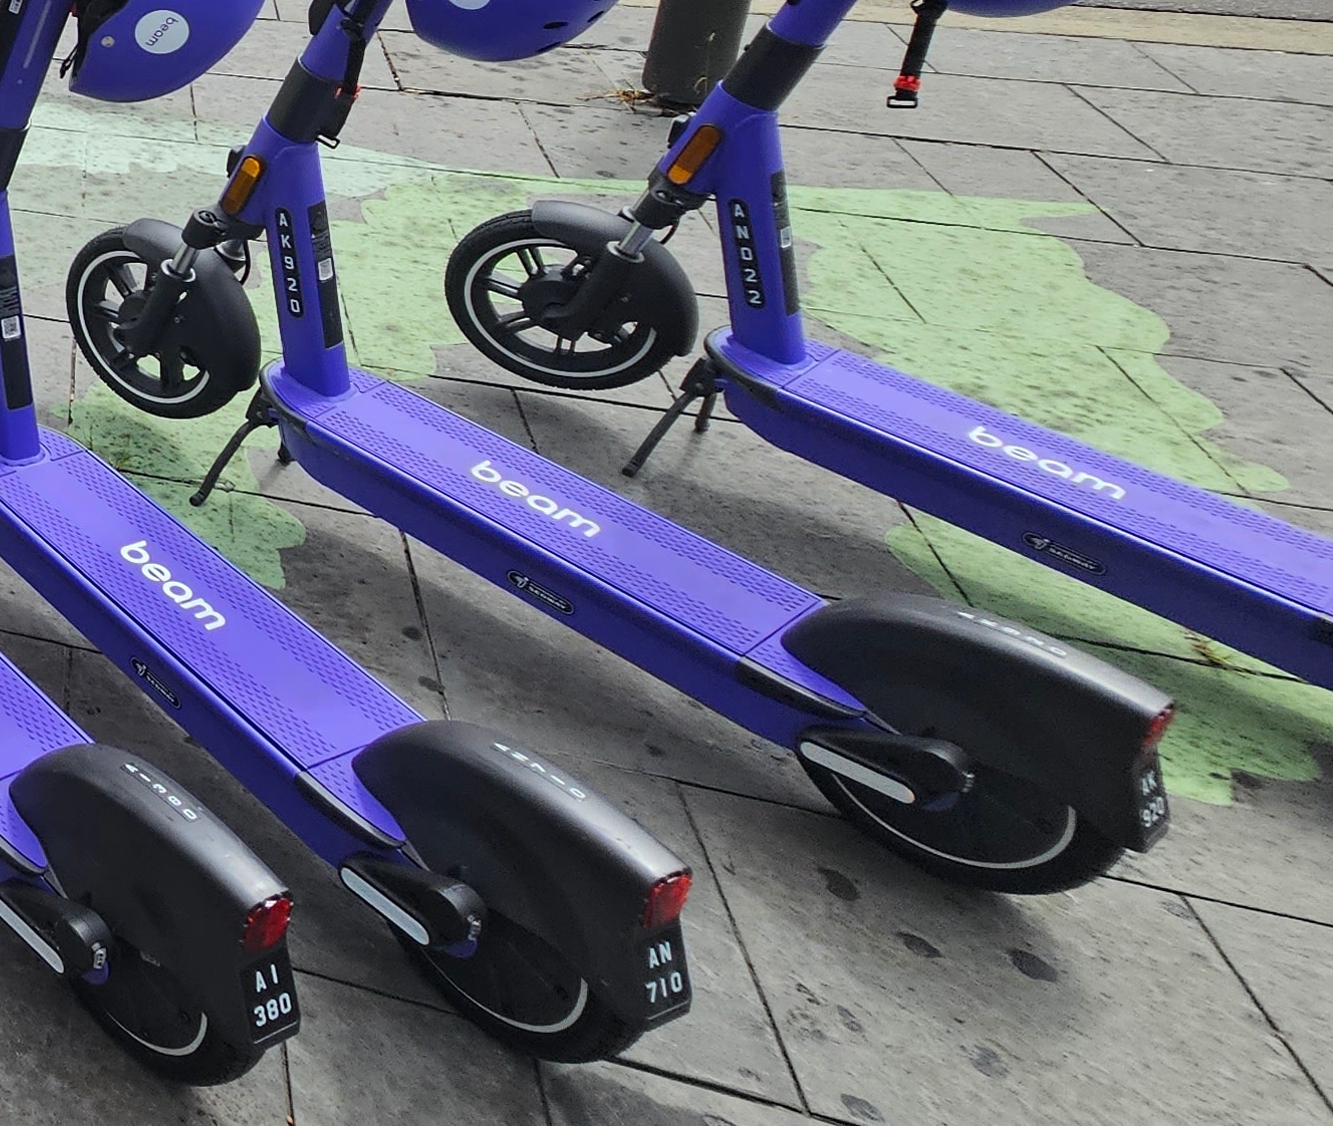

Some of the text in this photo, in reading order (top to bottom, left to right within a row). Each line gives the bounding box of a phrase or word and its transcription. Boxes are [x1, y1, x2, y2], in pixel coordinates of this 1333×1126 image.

[145, 16, 179, 47] beam
[968, 426, 1127, 500] beam
[471, 460, 601, 538] beam
[120, 540, 226, 631] beam
[648, 940, 673, 969] AN
[255, 963, 279, 994] AI
[644, 971, 683, 1004] 710
[253, 992, 293, 1027] 380
